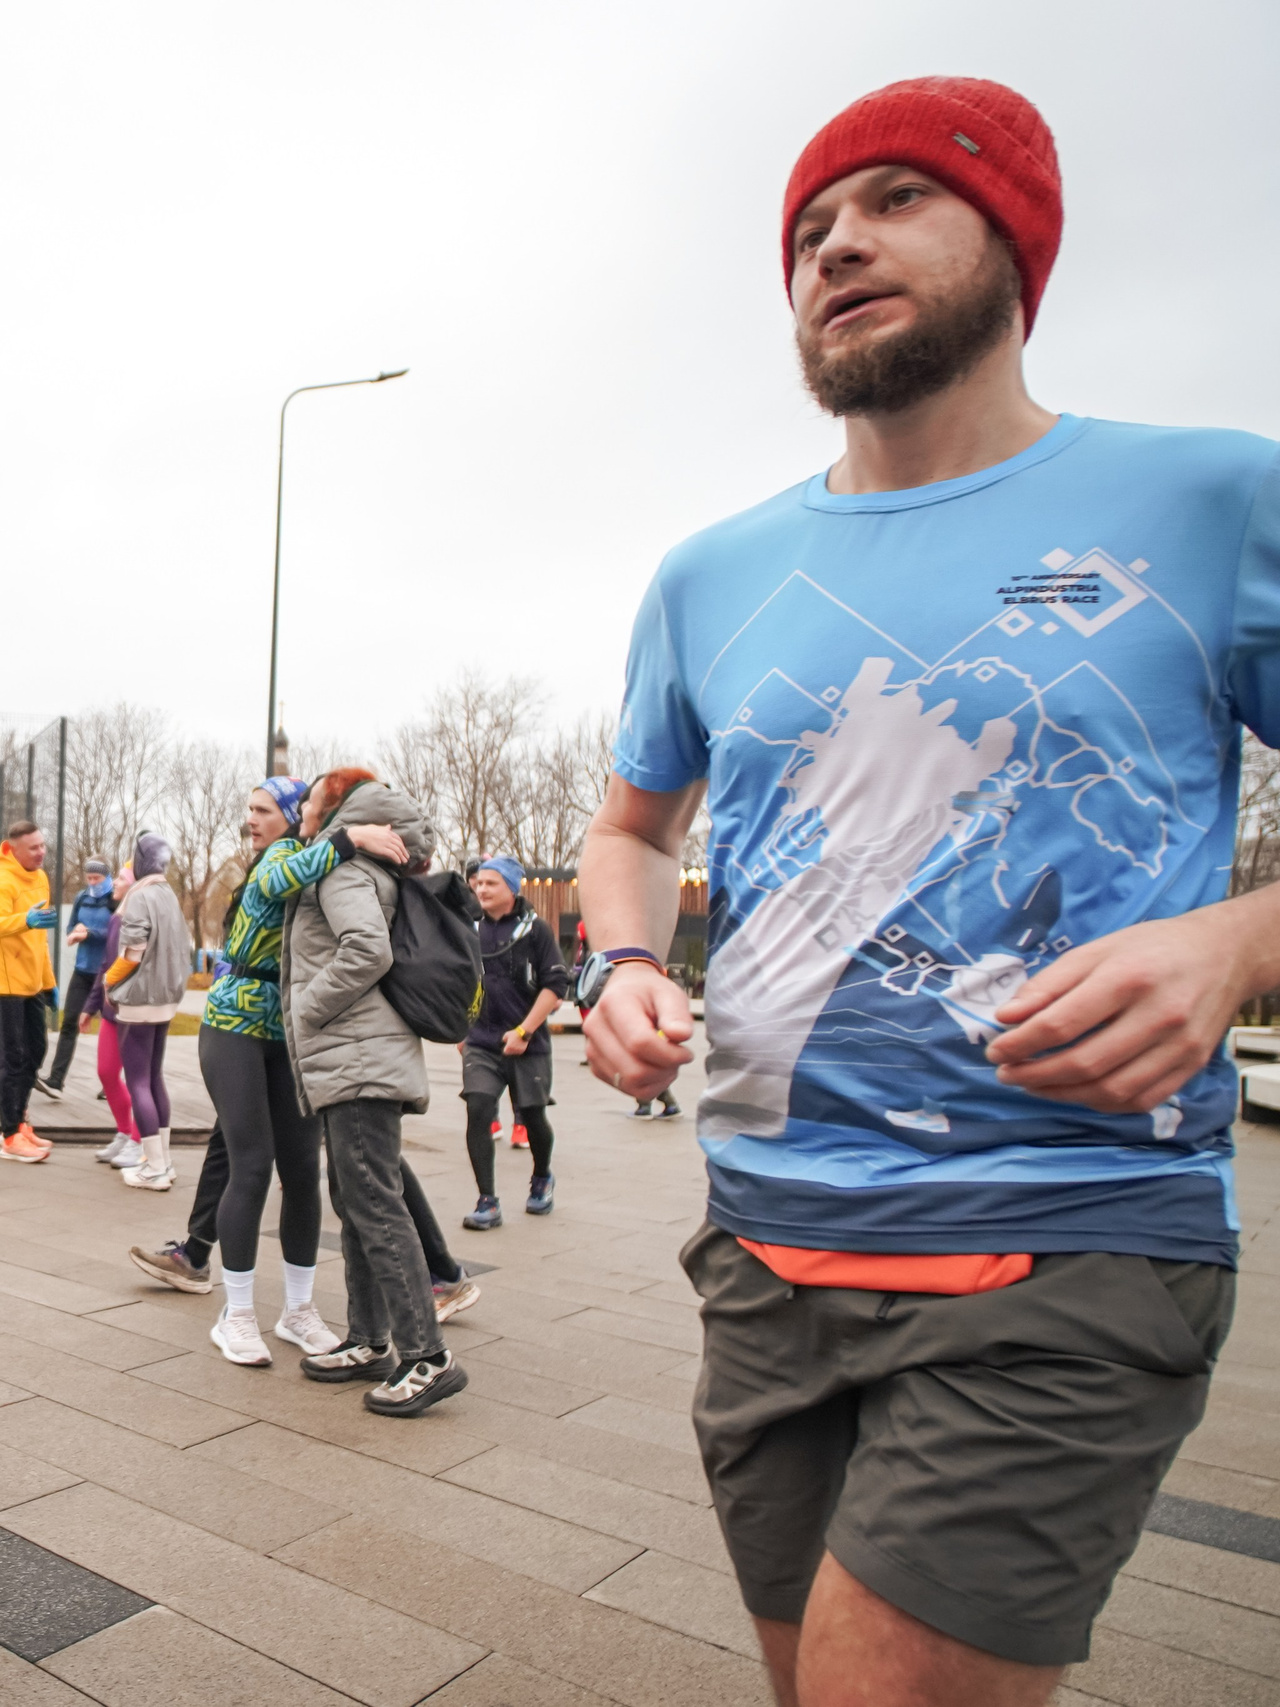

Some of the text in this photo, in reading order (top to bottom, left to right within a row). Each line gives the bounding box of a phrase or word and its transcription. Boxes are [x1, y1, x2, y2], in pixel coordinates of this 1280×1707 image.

[996, 584, 1101, 594] ALPINDUSTRIA
[1003, 595, 1100, 604] ELBRUS RACE
